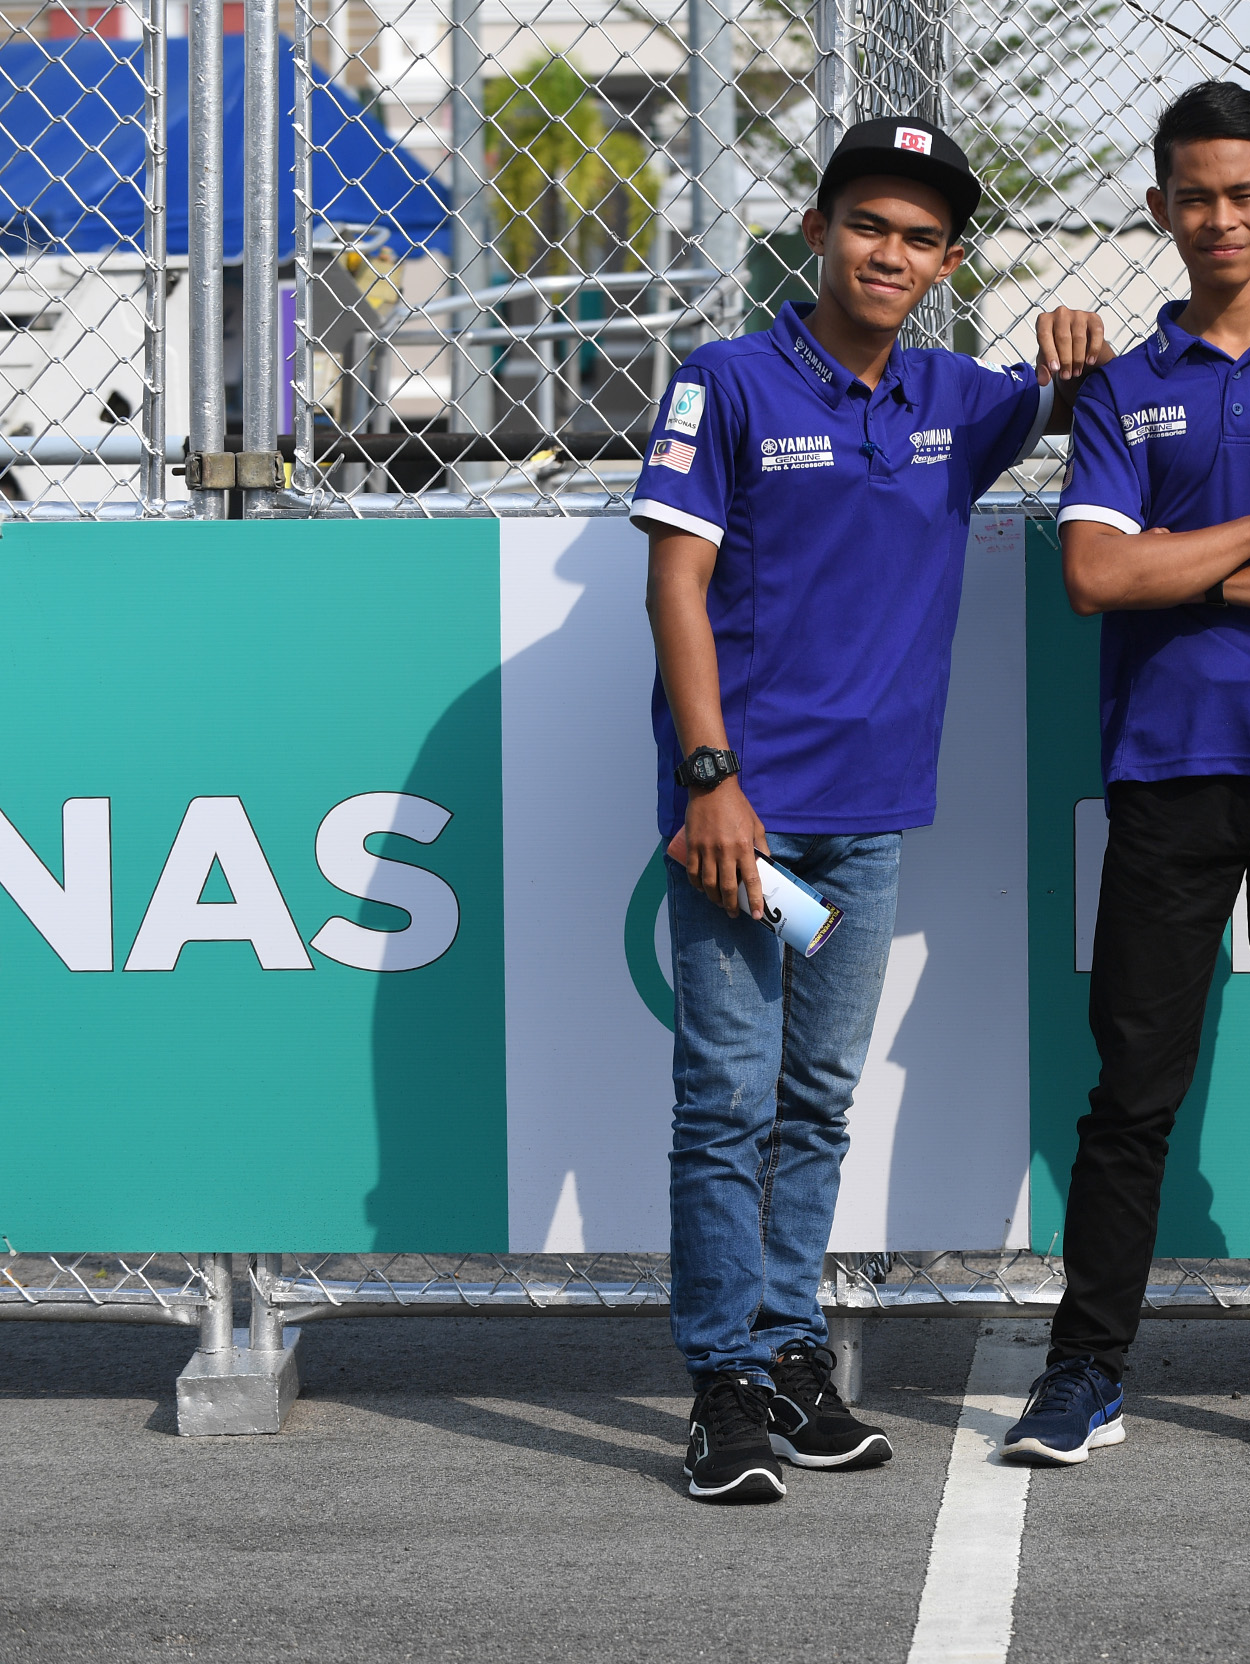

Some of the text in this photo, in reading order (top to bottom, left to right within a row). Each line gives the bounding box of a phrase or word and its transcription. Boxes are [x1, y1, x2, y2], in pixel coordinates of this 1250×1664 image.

[803, 344, 834, 383] YAMAHA
[1132, 405, 1187, 426] YAMAHA
[777, 435, 832, 453] YAMAHA
[761, 465, 782, 473] Parts
[790, 460, 835, 470] Accessories
[775, 453, 821, 464] GENUINE
[0, 791, 461, 973] NAS
